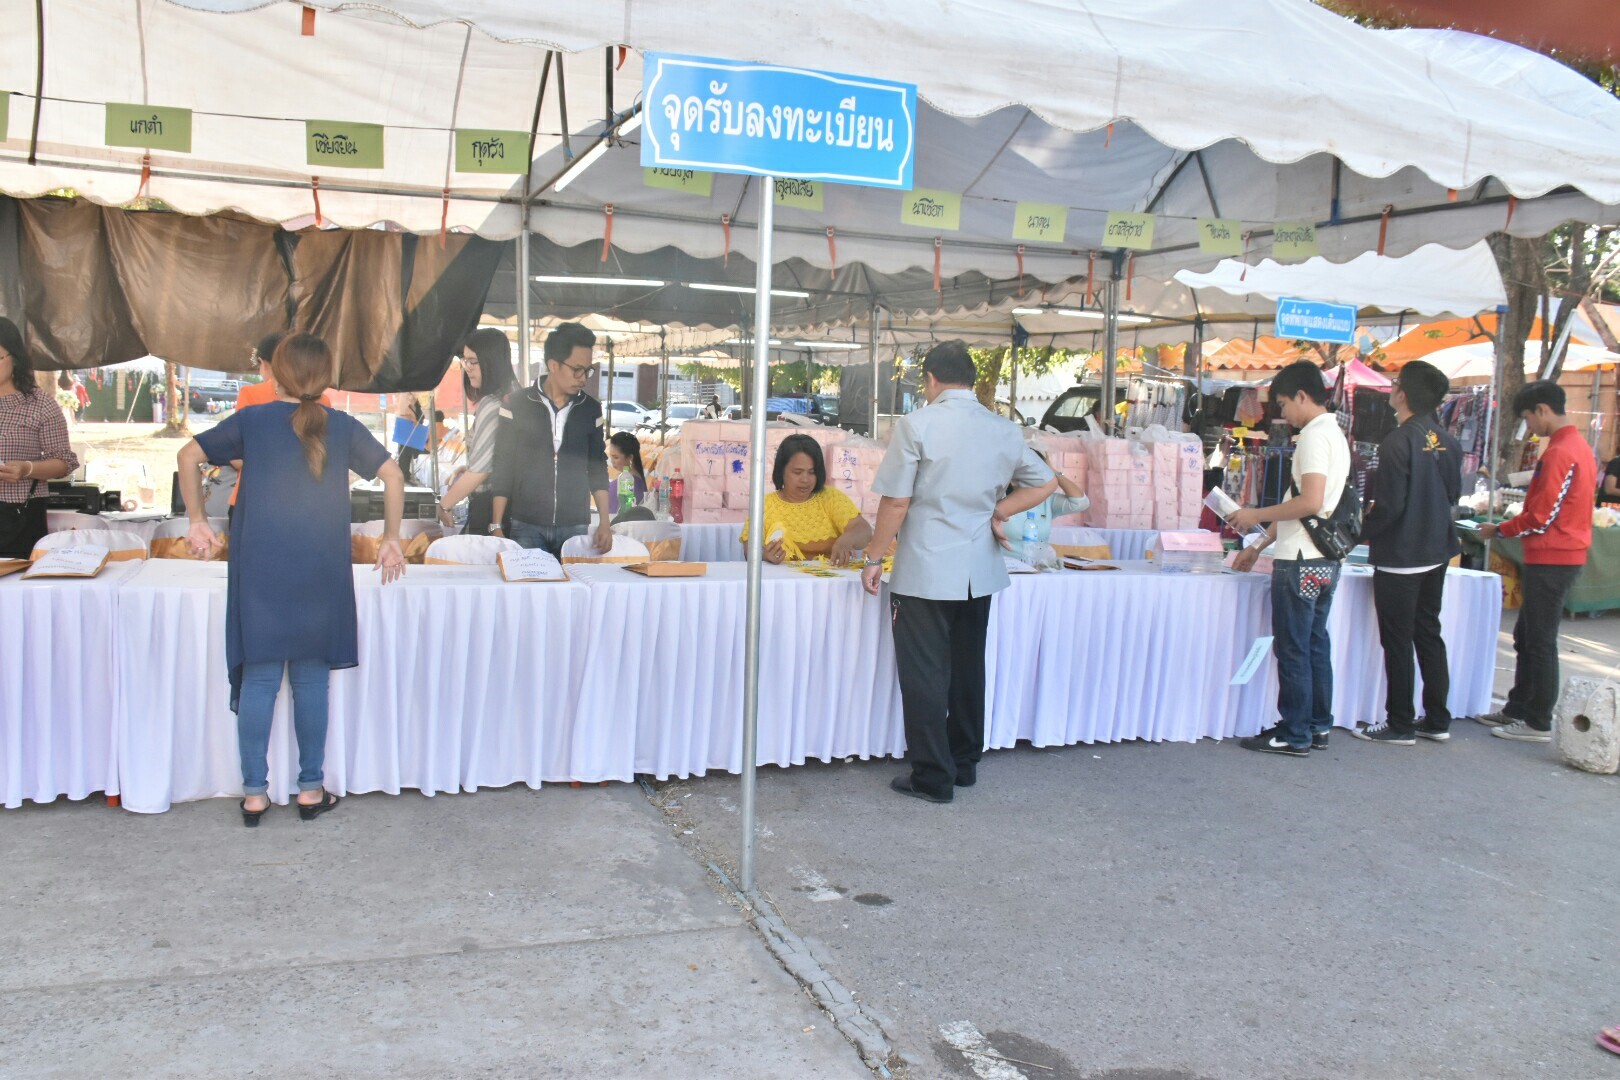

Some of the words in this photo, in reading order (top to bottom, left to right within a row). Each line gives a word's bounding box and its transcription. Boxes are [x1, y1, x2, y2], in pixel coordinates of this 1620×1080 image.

[130, 114, 163, 135] แกดำ
[661, 80, 894, 152] จุดรับลงทะเบียน
[472, 137, 504, 167] กุดรัง
